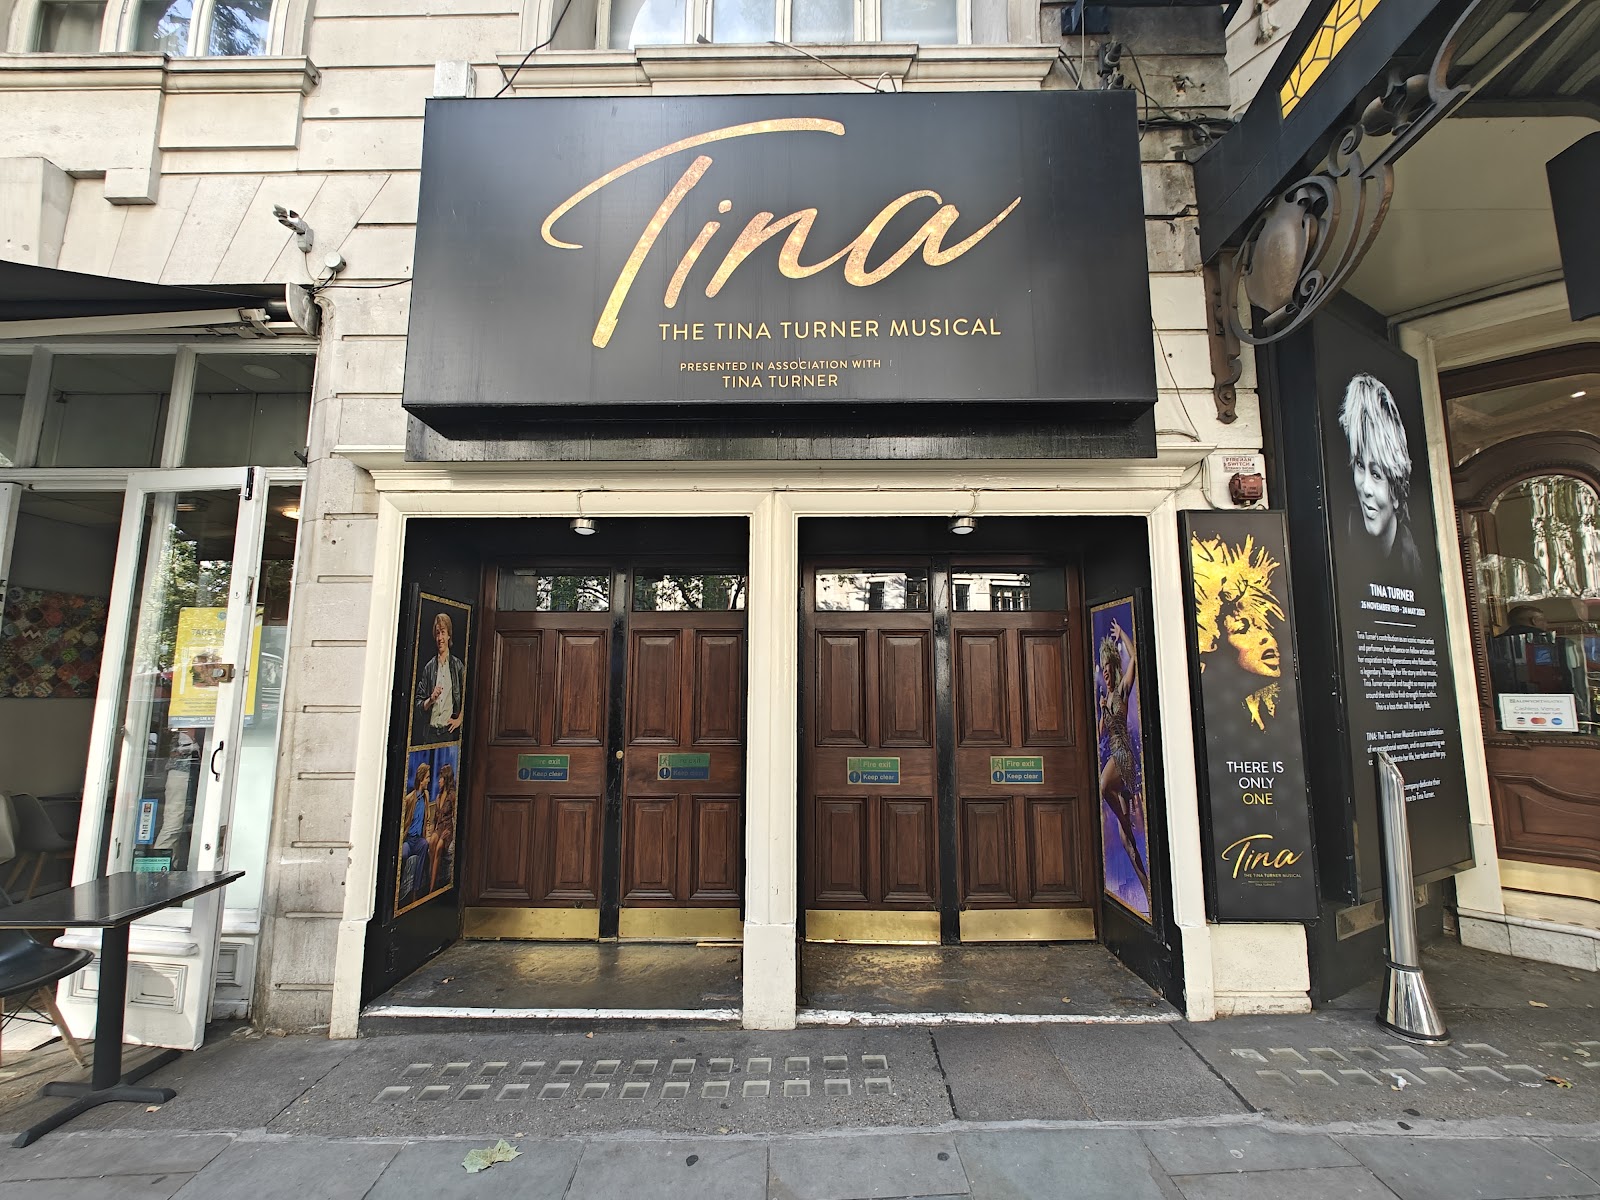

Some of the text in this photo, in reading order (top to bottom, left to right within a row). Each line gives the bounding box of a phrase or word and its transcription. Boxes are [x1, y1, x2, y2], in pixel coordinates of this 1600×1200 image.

[540, 117, 1022, 349] Tina
[659, 318, 1002, 342] THE TINA TURNER MUSICAL
[680, 360, 881, 372] PRESENTED IN ASSOCIATION WITH
[722, 373, 838, 388] TINA TURNER
[1370, 583, 1414, 602] TINA TURNER
[1367, 602, 1390, 612] NOVEMBER
[1402, 606, 1407, 614] 24
[1408, 607, 1417, 615] MAY
[1375, 702, 1383, 710] This
[1226, 761, 1284, 773] THERE IS
[1238, 777, 1274, 789] ONLY
[1242, 792, 1273, 805] ONE
[1416, 792, 1424, 800] Tina
[1221, 834, 1304, 879] Tina
